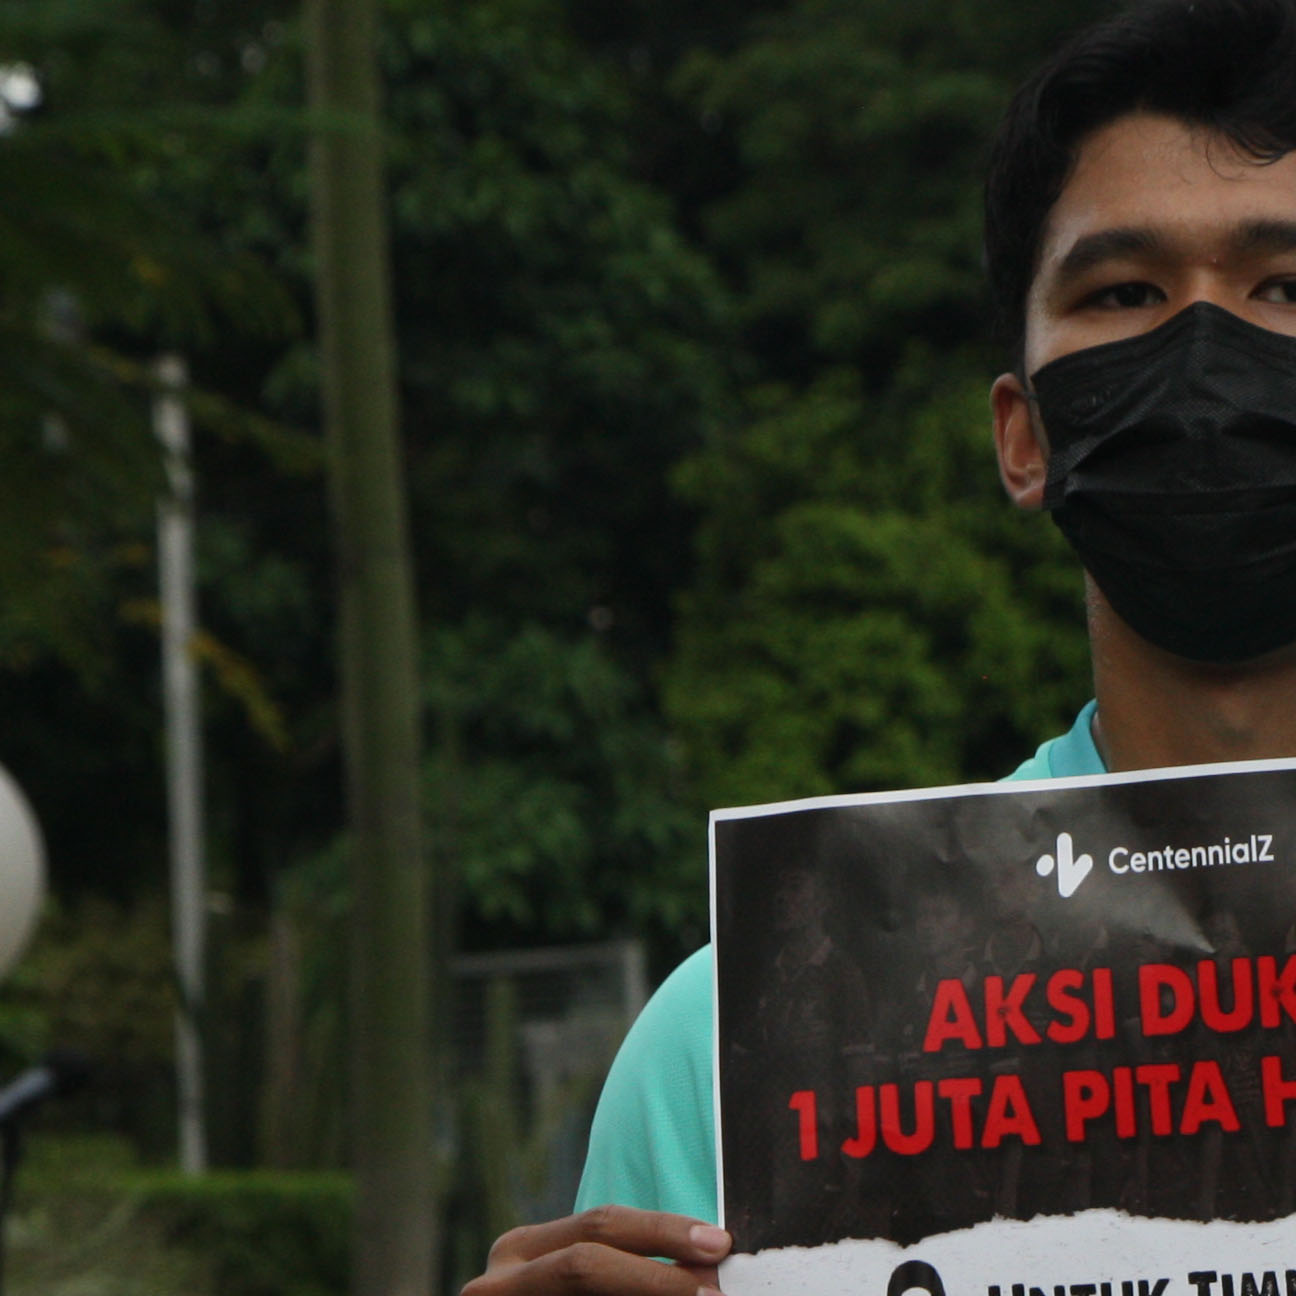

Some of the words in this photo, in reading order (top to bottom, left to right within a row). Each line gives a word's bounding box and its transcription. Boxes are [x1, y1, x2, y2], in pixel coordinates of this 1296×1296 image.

[1108, 834, 1275, 874] CentennialZ
[923, 967, 1116, 1053] AKSI
[788, 1090, 819, 1161] 1
[841, 1074, 1042, 1159] JUTA
[1063, 1060, 1241, 1142] PITA
